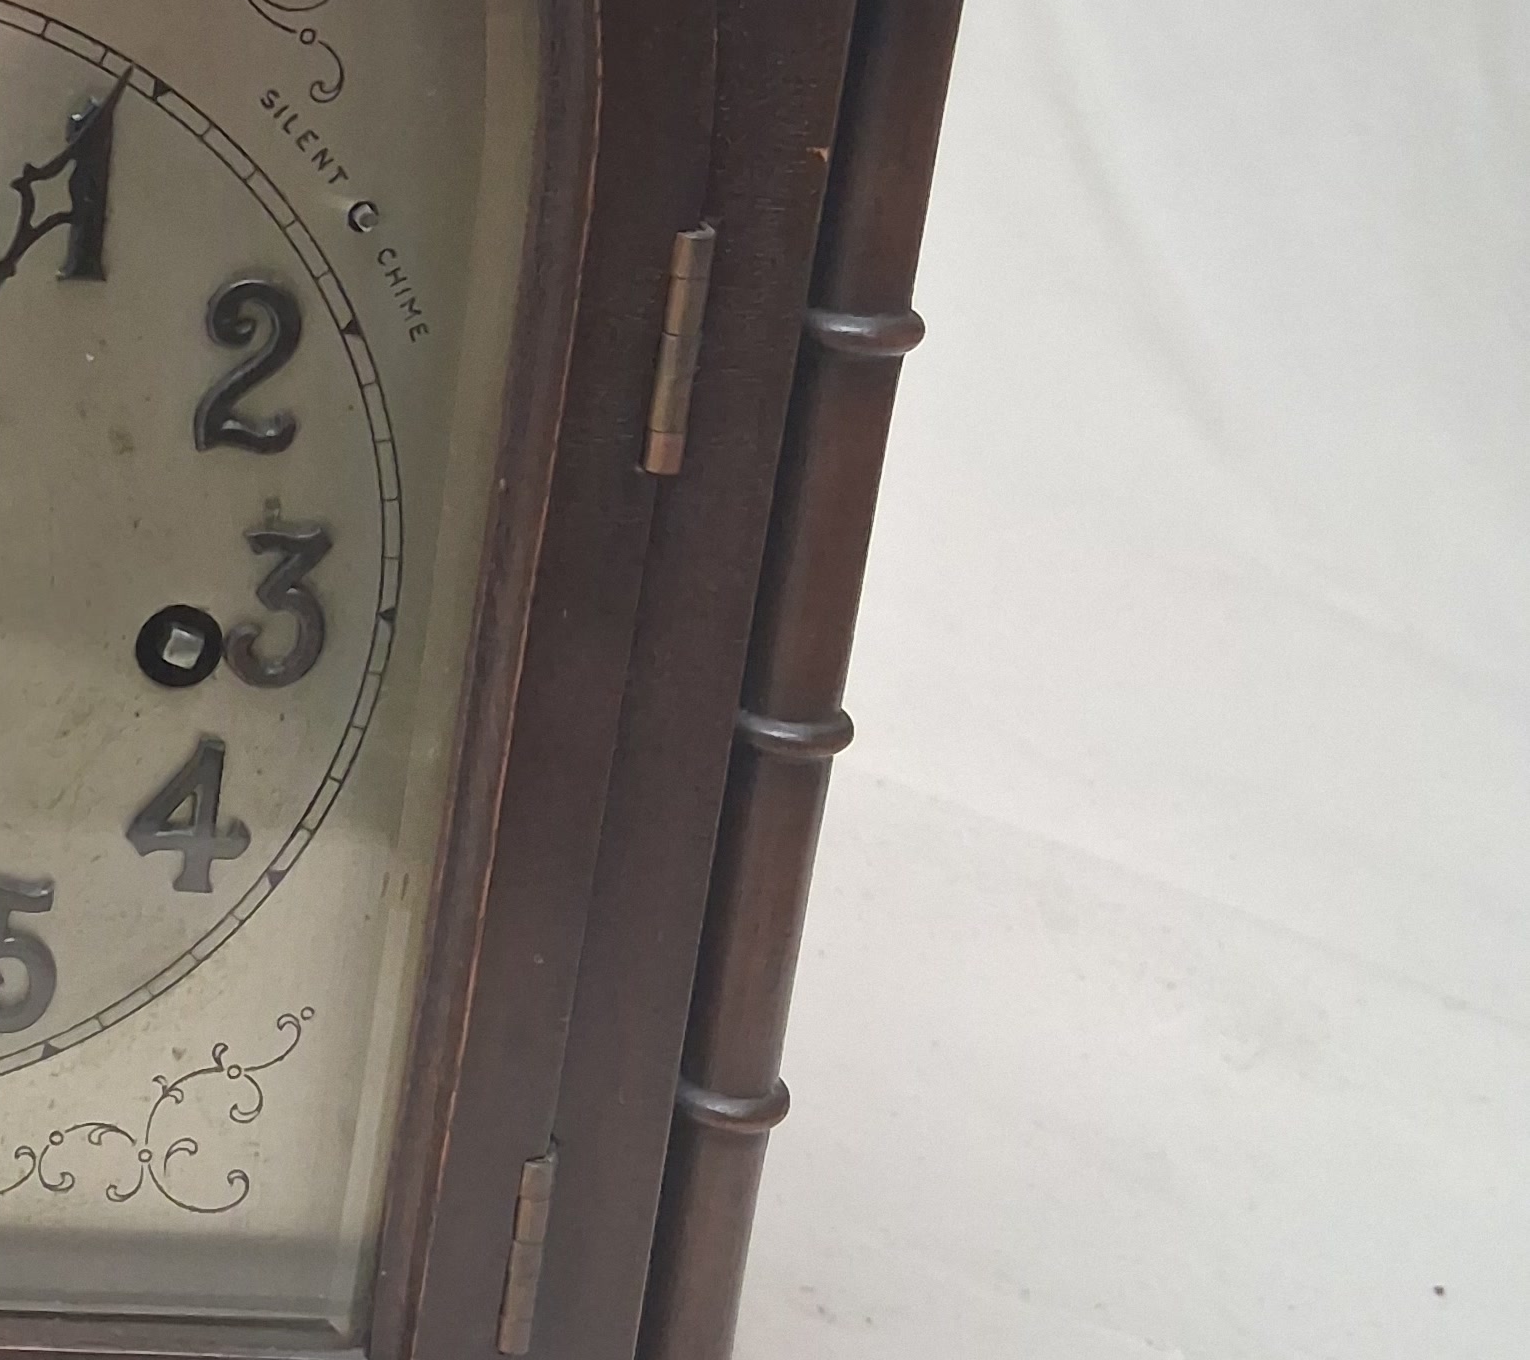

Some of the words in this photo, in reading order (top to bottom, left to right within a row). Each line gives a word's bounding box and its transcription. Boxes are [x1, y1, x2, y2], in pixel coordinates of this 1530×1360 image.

[260, 89, 349, 185] SILENT
[194, 278, 303, 453] 2
[377, 247, 430, 343] CHIME
[222, 523, 334, 689] 3
[125, 735, 252, 894] 4
